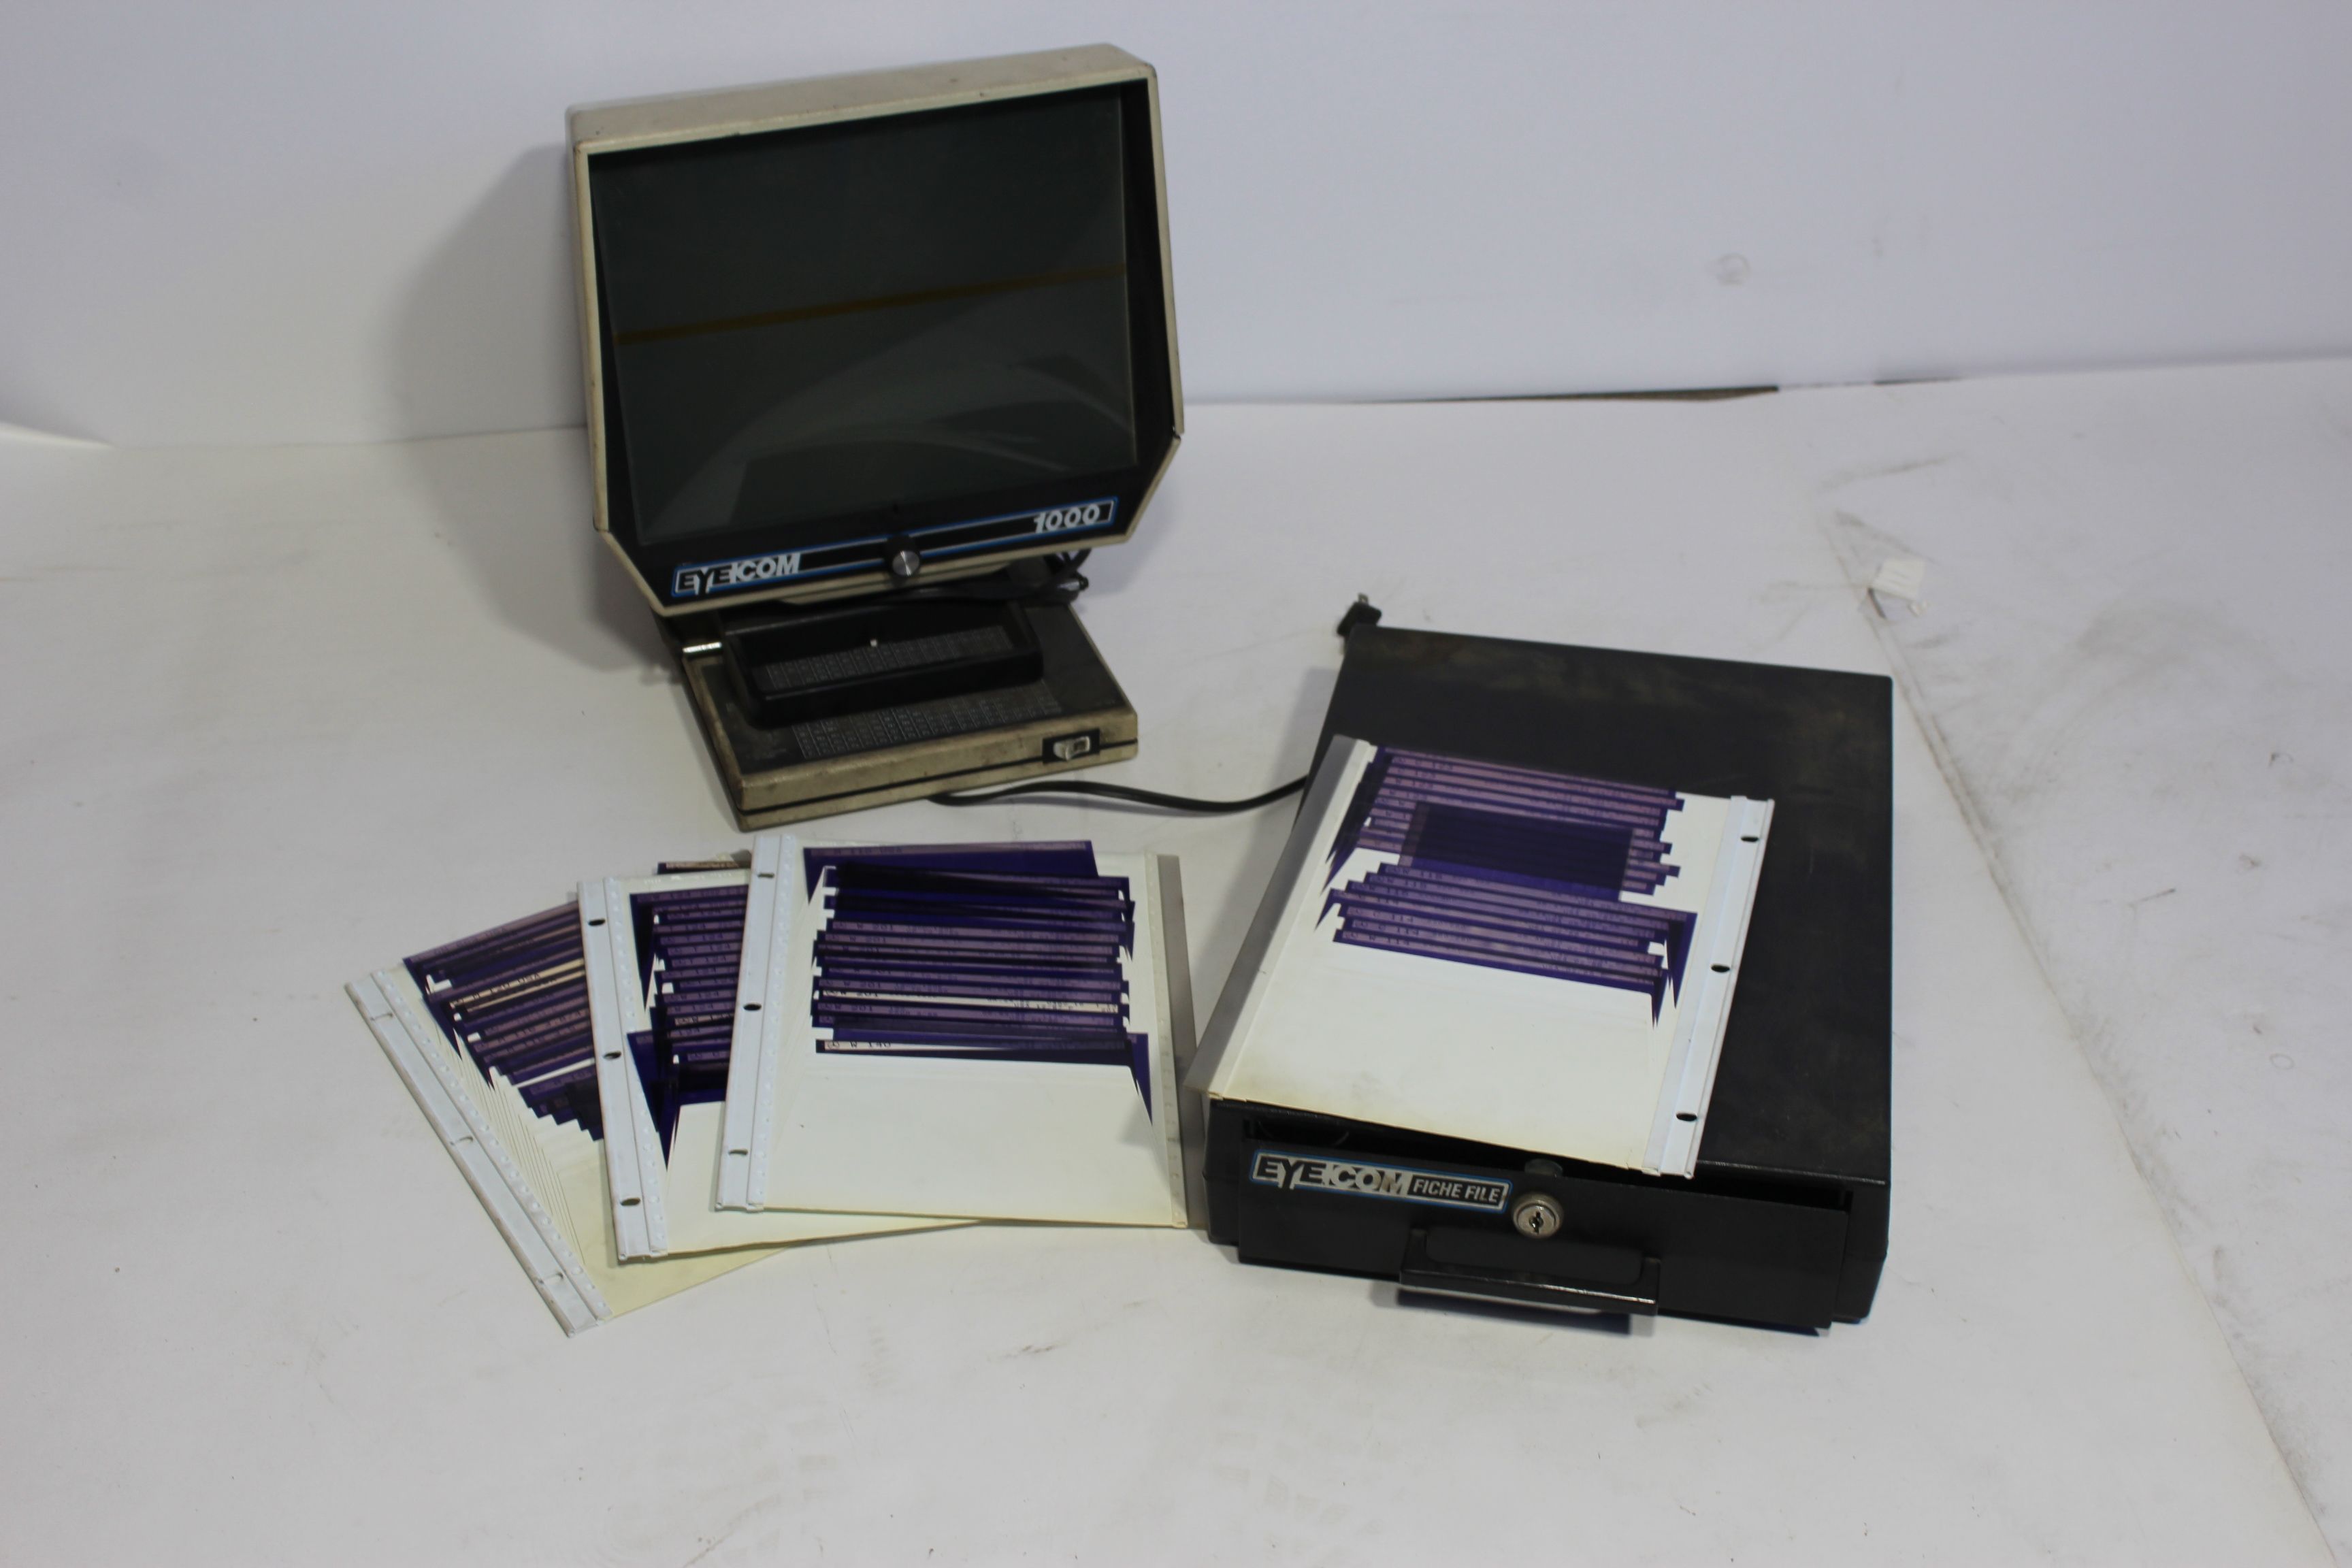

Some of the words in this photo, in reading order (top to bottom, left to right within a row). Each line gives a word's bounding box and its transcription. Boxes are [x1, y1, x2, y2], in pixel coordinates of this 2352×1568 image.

[1033, 504, 1101, 534] 1000
[1413, 1179, 1462, 1199] FICHE
[1465, 1184, 1501, 1203] FILE
